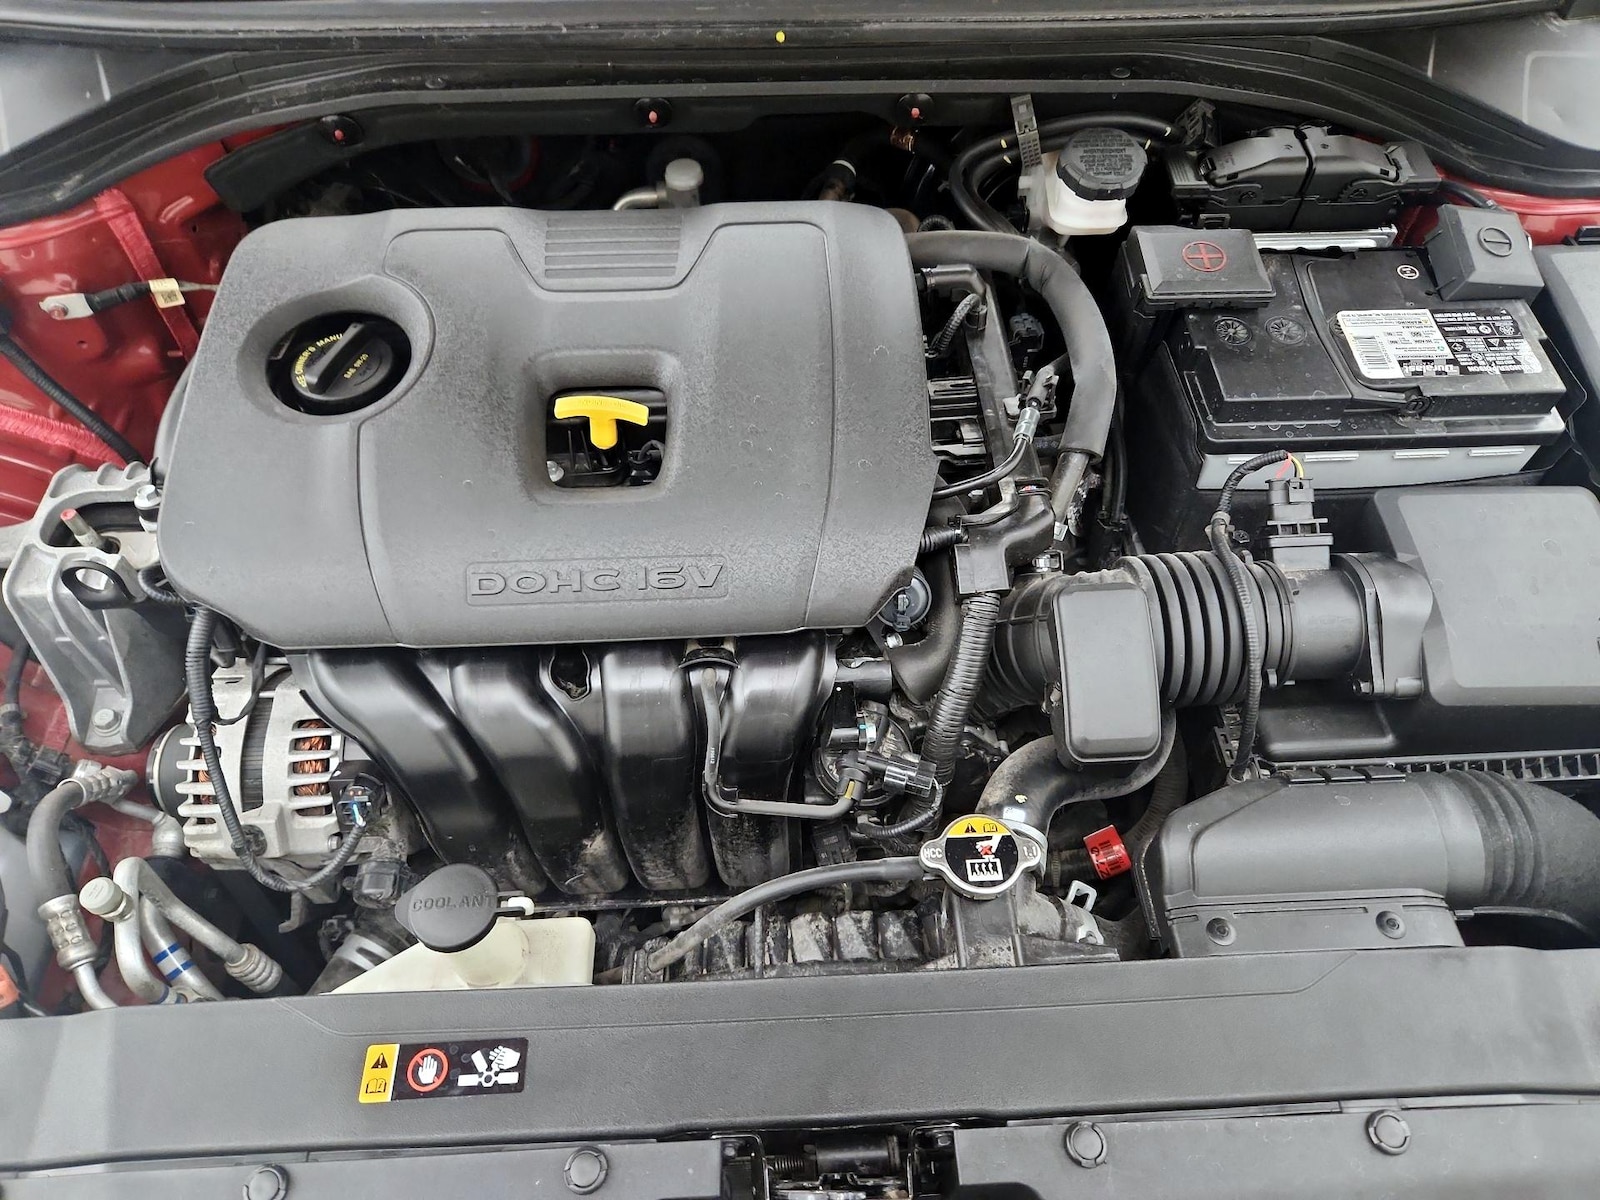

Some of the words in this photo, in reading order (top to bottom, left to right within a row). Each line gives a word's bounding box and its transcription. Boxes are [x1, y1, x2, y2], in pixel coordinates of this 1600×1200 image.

[316, 333, 343, 347] MANU
[1402, 364, 1456, 374] Duralast
[470, 568, 621, 597] DOHC
[636, 563, 724, 591] 16V
[923, 847, 943, 859] HCC
[1023, 845, 1038, 858] 1.1
[413, 892, 495, 912] COOLANT
